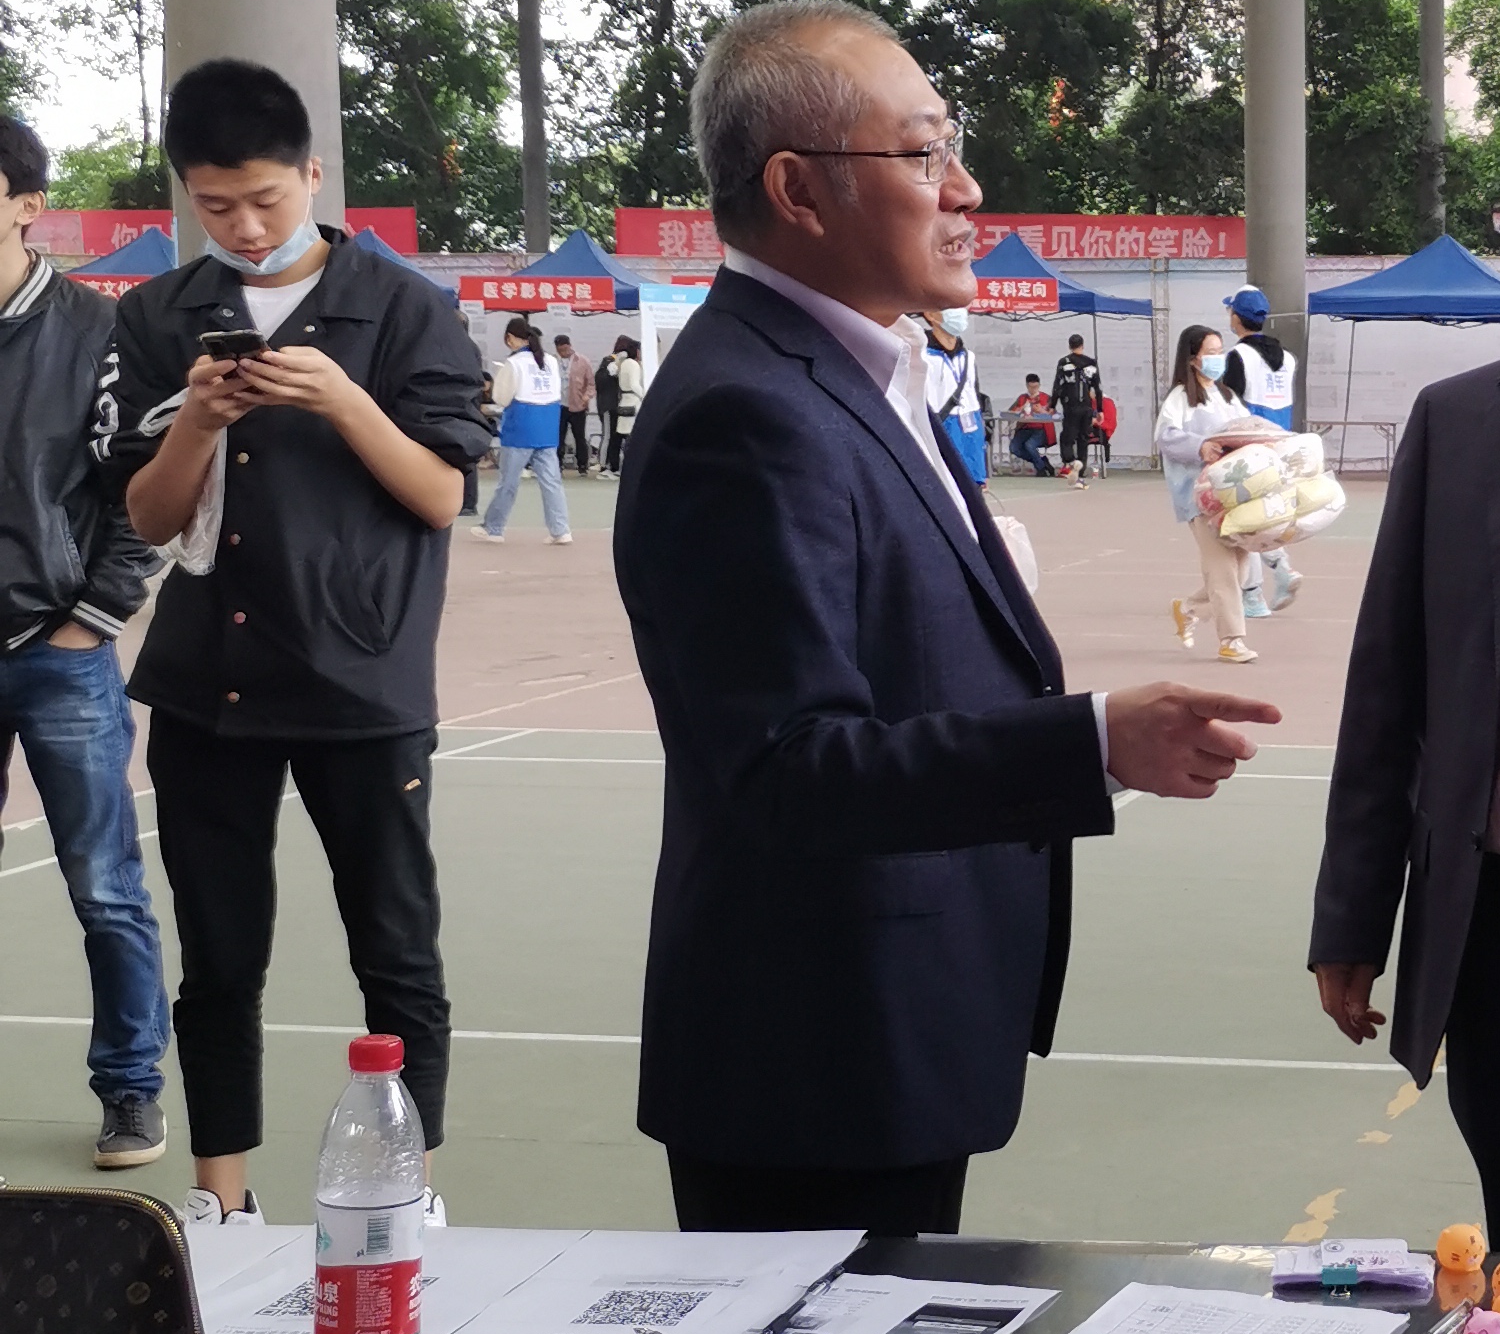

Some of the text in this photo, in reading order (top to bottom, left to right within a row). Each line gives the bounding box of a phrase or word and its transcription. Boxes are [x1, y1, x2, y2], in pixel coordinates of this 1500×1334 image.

[483, 281, 593, 300] 医学影像学院
[986, 280, 1047, 298] 专科定向
